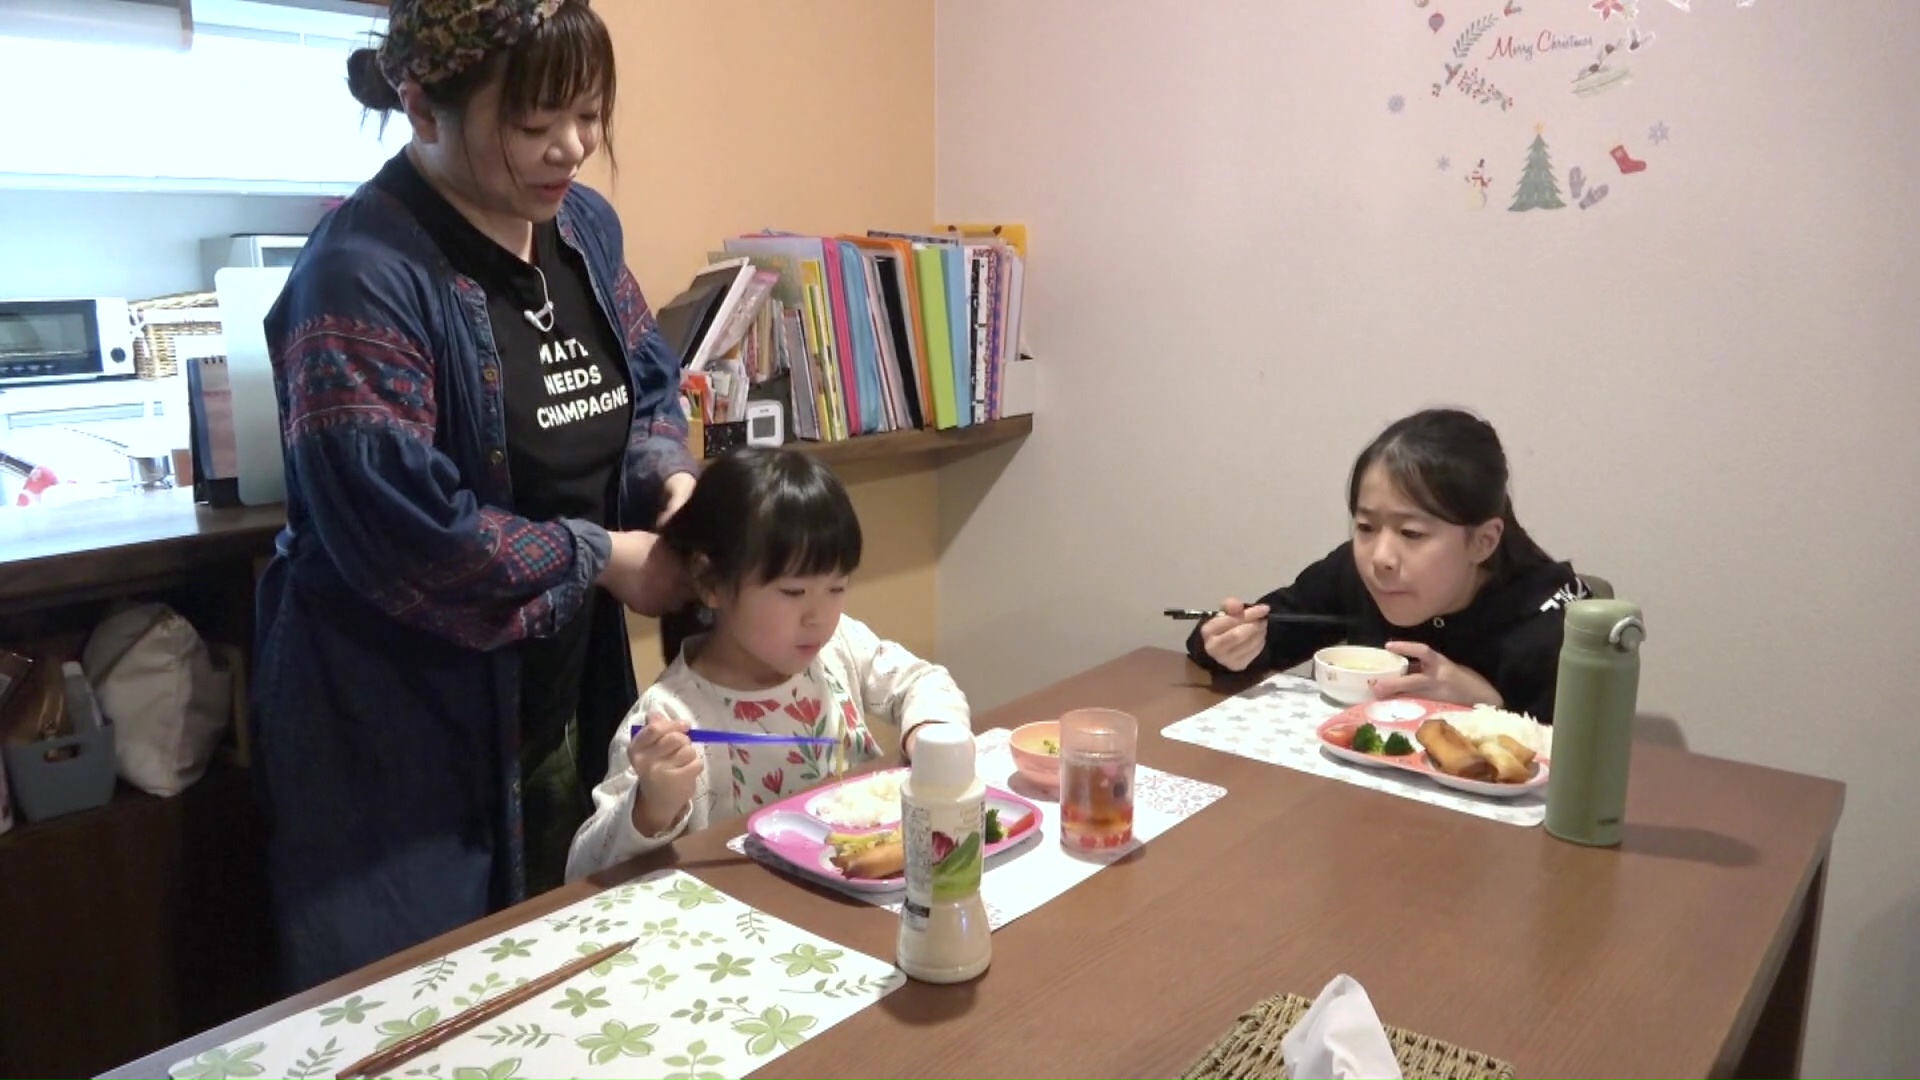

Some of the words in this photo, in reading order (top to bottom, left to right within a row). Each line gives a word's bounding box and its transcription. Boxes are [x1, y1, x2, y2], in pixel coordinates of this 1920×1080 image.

[1488, 36, 1533, 61] Merry
[1536, 29, 1593, 52] Christmas
[543, 364, 602, 396] NEEDS
[536, 385, 628, 429] CHAMPAGNE
